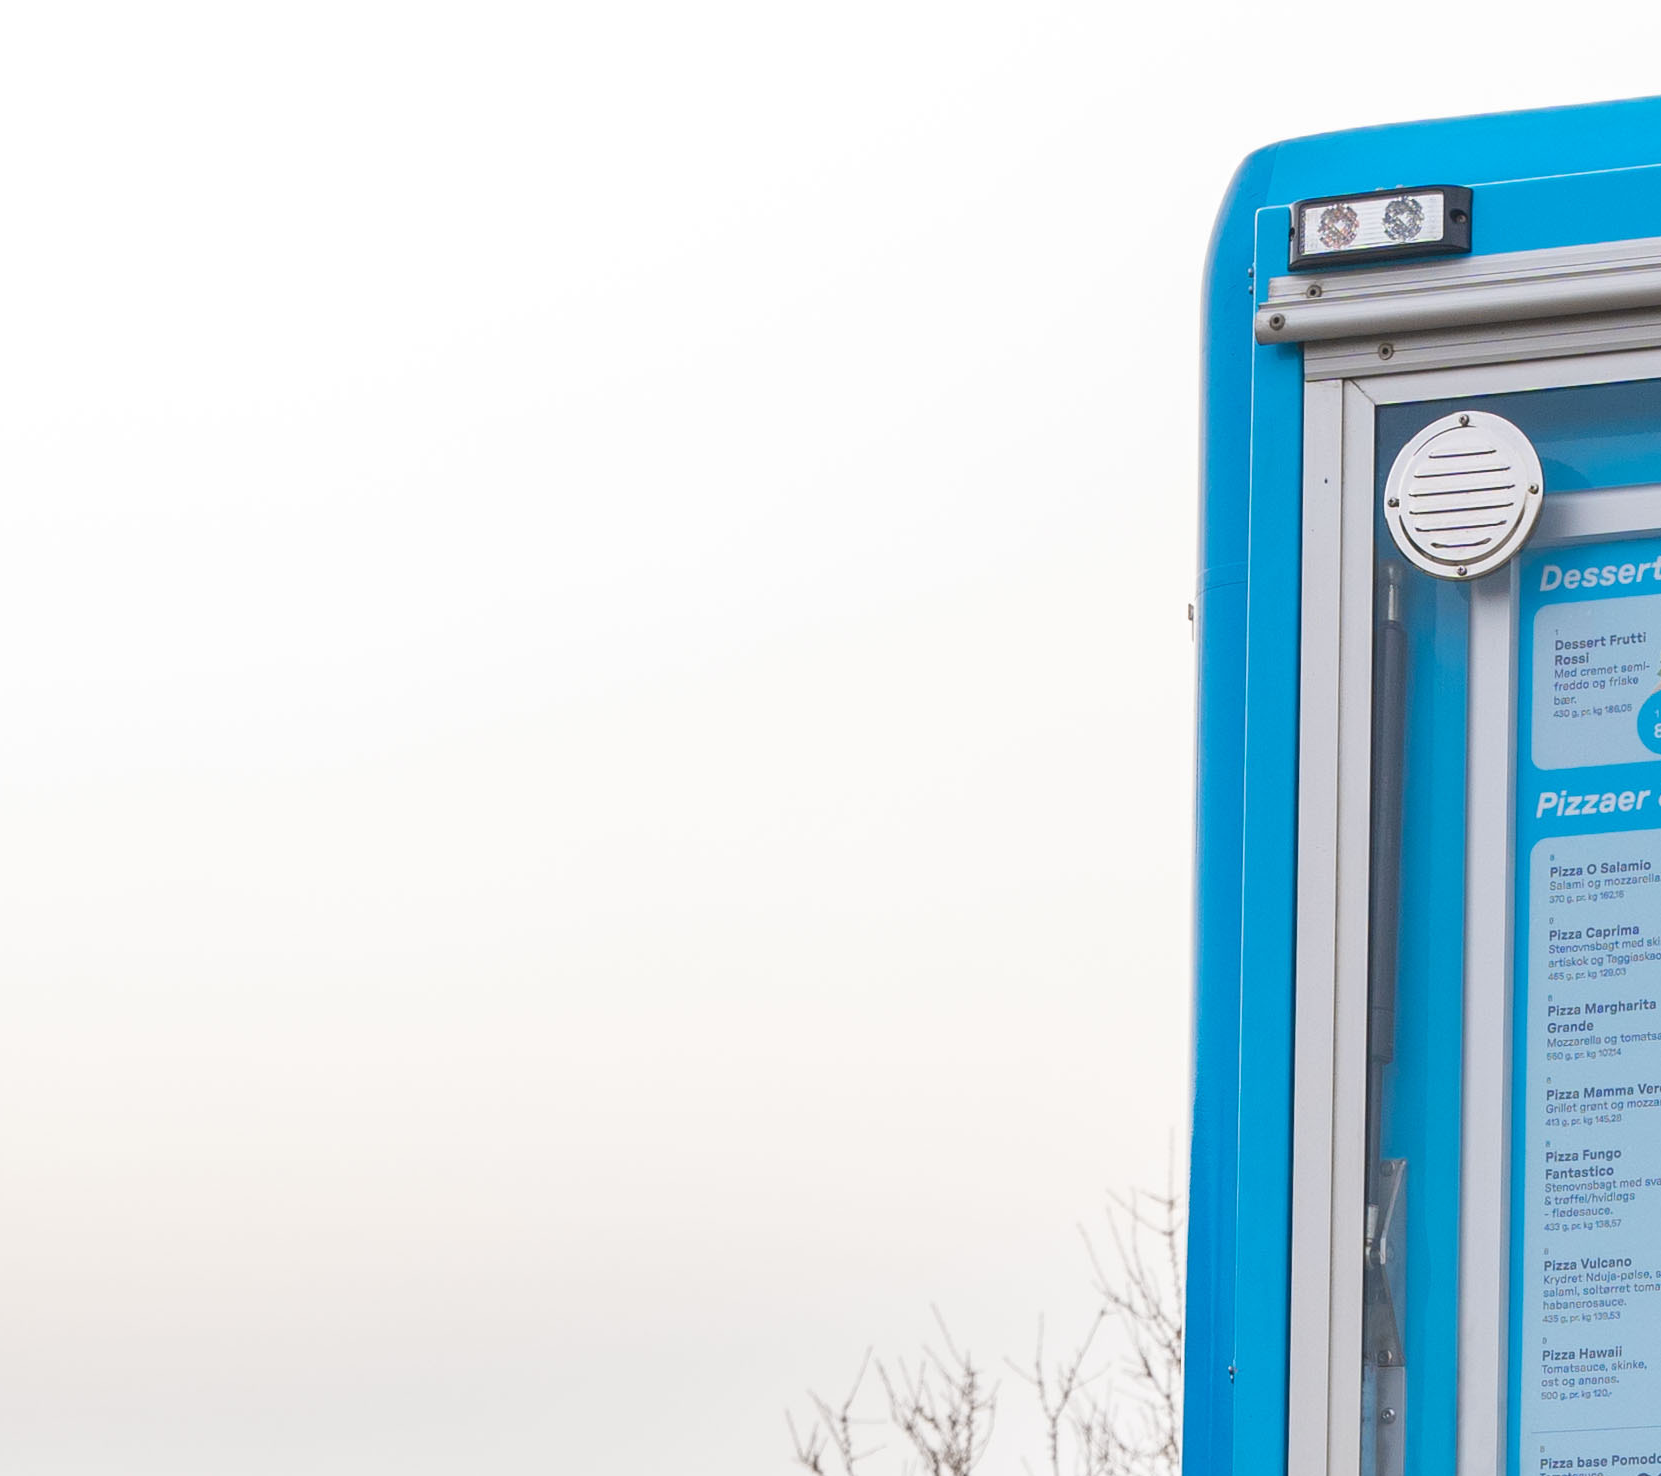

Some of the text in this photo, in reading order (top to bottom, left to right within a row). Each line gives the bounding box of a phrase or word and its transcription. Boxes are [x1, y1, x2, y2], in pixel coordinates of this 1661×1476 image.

[1555, 632, 1646, 650] Dessert Frutti
[1555, 652, 1589, 665] Rossi
[1537, 790, 1651, 818] Pizzaer
[1550, 860, 1651, 877] Pizza O Salamio
[1588, 880, 1601, 889] og
[1547, 1089, 1579, 1101] Pizza
[1584, 1087, 1634, 1098] Mamma
